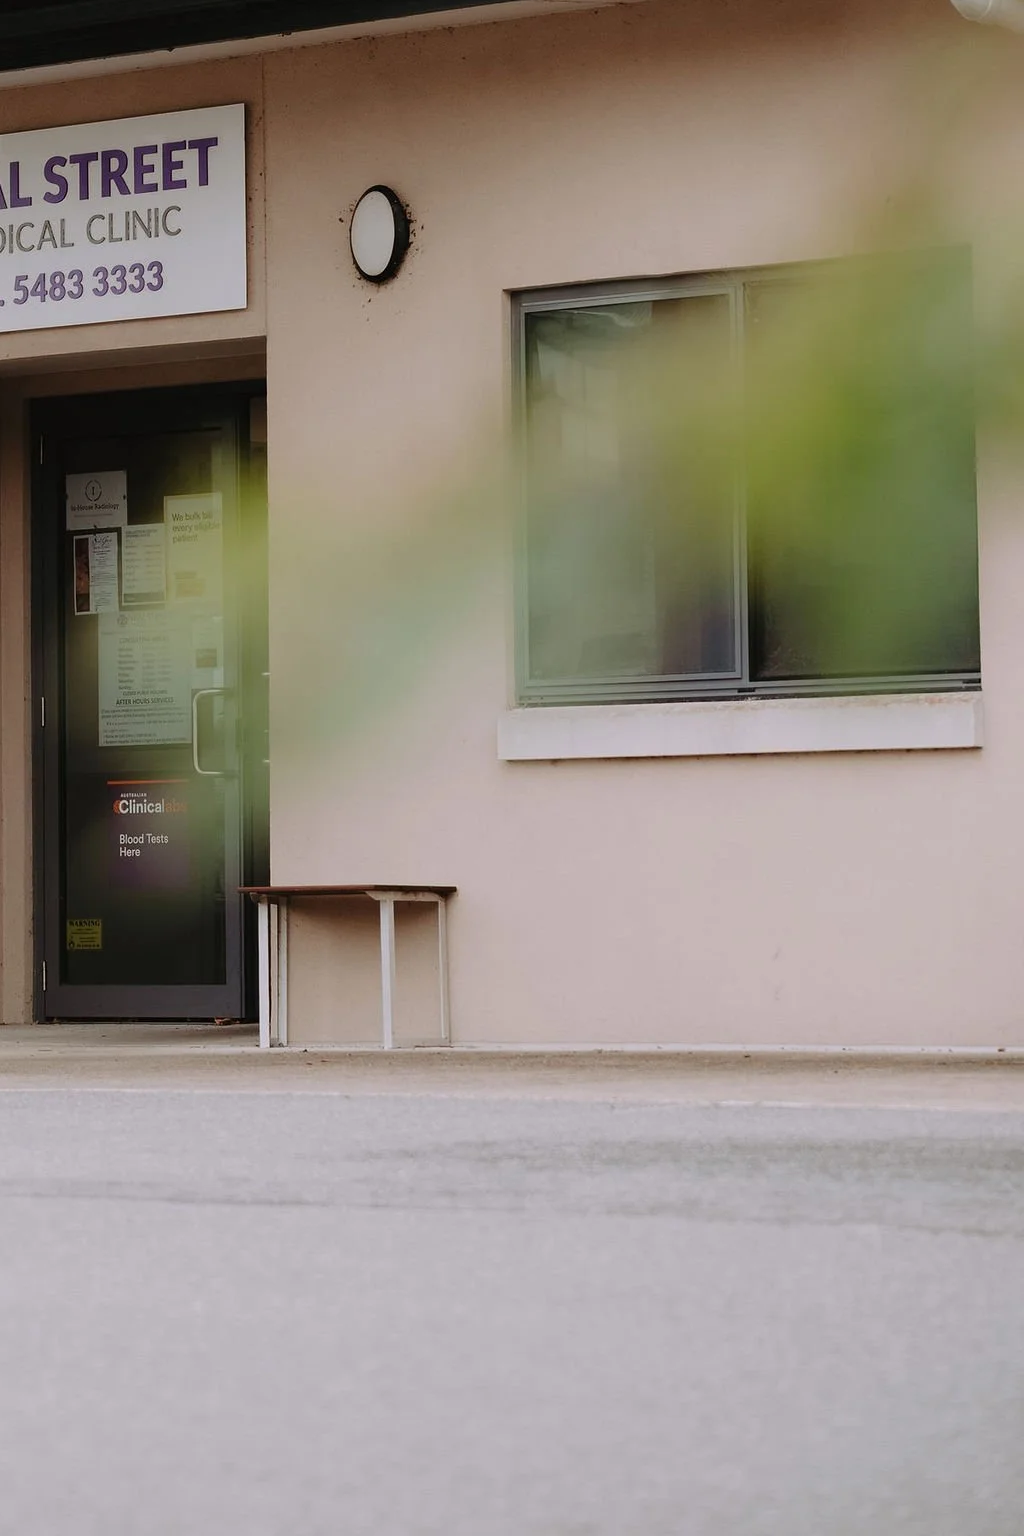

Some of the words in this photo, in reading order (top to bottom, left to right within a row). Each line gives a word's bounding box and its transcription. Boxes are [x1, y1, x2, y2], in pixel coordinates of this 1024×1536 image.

[43, 137, 218, 204] STREET
[86, 205, 182, 245] CLINIC
[13, 268, 84, 305] 5483
[92, 260, 164, 297] 3333
[94, 502, 120, 512] Radiology
[171, 512, 183, 521] We
[172, 524, 192, 532] every
[120, 834, 144, 844] Blood
[146, 833, 169, 844] Tests
[120, 846, 141, 857] Here
